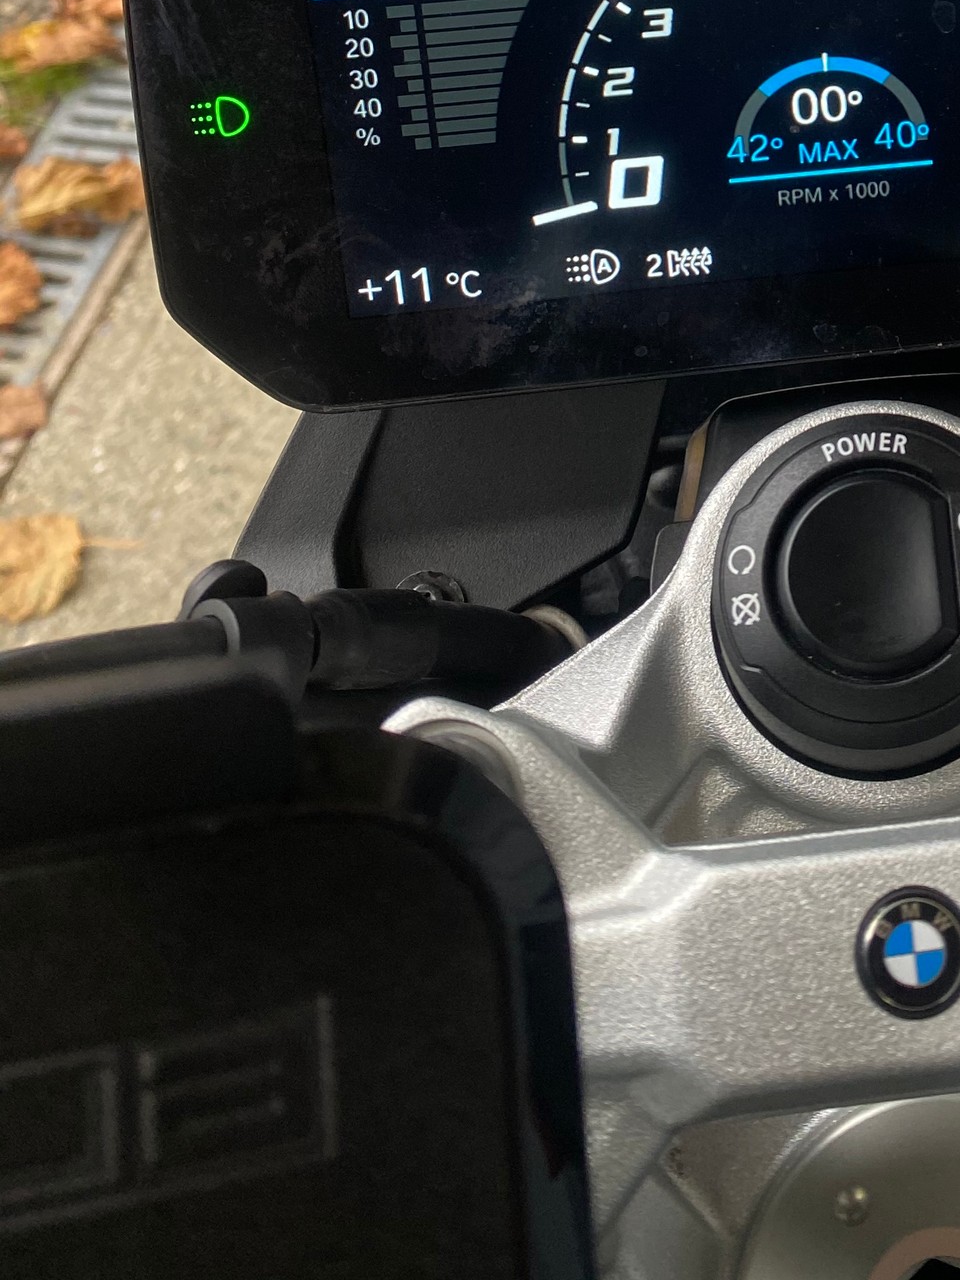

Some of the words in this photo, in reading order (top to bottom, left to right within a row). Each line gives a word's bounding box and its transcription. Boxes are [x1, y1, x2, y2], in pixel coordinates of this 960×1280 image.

[342, 8, 369, 30] 10
[641, 7, 674, 39] 3
[344, 37, 375, 59] 20
[349, 68, 379, 90] 30
[602, 66, 636, 97] 2
[353, 97, 382, 118] 40
[355, 127, 381, 147] %
[607, 127, 620, 156] 1
[798, 138, 859, 164] MAX
[608, 155, 665, 210] 0
[777, 186, 822, 207] RPM
[845, 180, 890, 200] 1000
[596, 257, 613, 274] A
[646, 253, 664, 278] 2
[357, 266, 431, 305] +11
[820, 431, 908, 463] POWER
